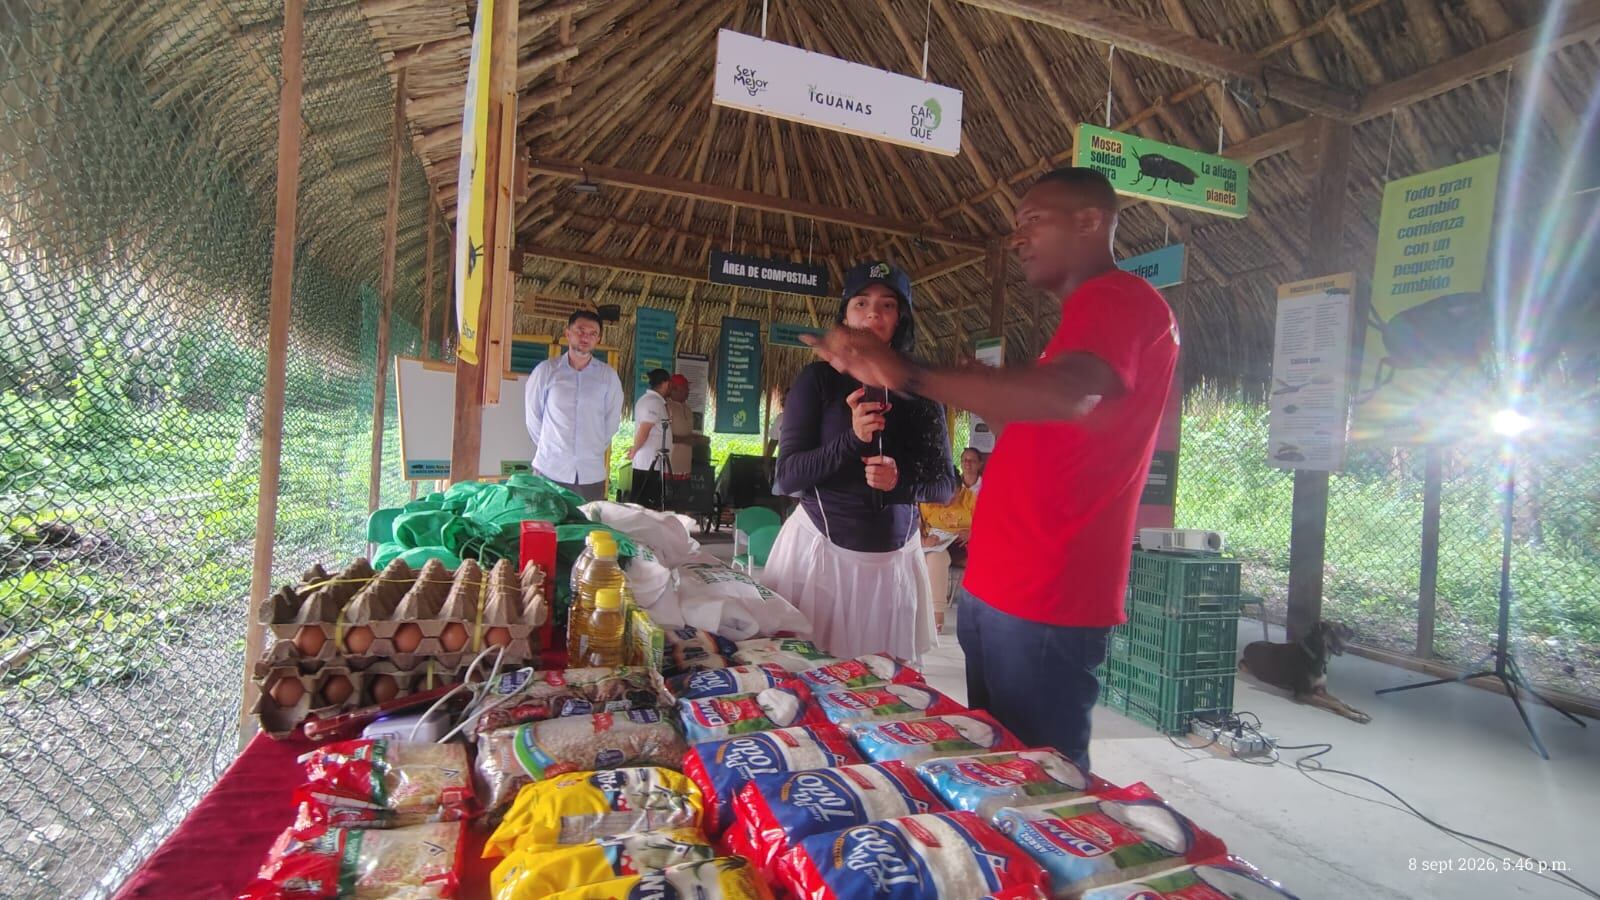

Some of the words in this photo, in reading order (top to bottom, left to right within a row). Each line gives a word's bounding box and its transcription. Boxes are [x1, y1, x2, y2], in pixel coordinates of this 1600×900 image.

[735, 64, 757, 77] Ser
[733, 74, 769, 96] Mejor
[809, 90, 872, 115] IGUANAS
[910, 126, 932, 141] QUE
[1091, 135, 1122, 154] Mosca
[1090, 150, 1127, 169] soldado
[1201, 161, 1211, 175] La
[1212, 163, 1237, 181] aliada
[1206, 188, 1237, 206] planeta
[1224, 180, 1237, 193] del
[1404, 184, 1436, 203] Todo
[1439, 176, 1473, 196] gran
[1408, 197, 1460, 220] cambio
[1397, 215, 1465, 240] comienza
[1403, 240, 1430, 257] con
[1432, 236, 1451, 251] un
[722, 259, 746, 277] ÁREA
[748, 265, 760, 279] DE
[761, 266, 818, 287] COMPOSTAJE
[1392, 254, 1455, 278] pequeño
[1391, 275, 1451, 296] zumbido
[731, 739, 778, 778] Todo
[791, 791, 818, 807] Pa
[796, 774, 855, 821] Todo
[848, 827, 919, 892] Todo
[639, 874, 664, 900] AN
